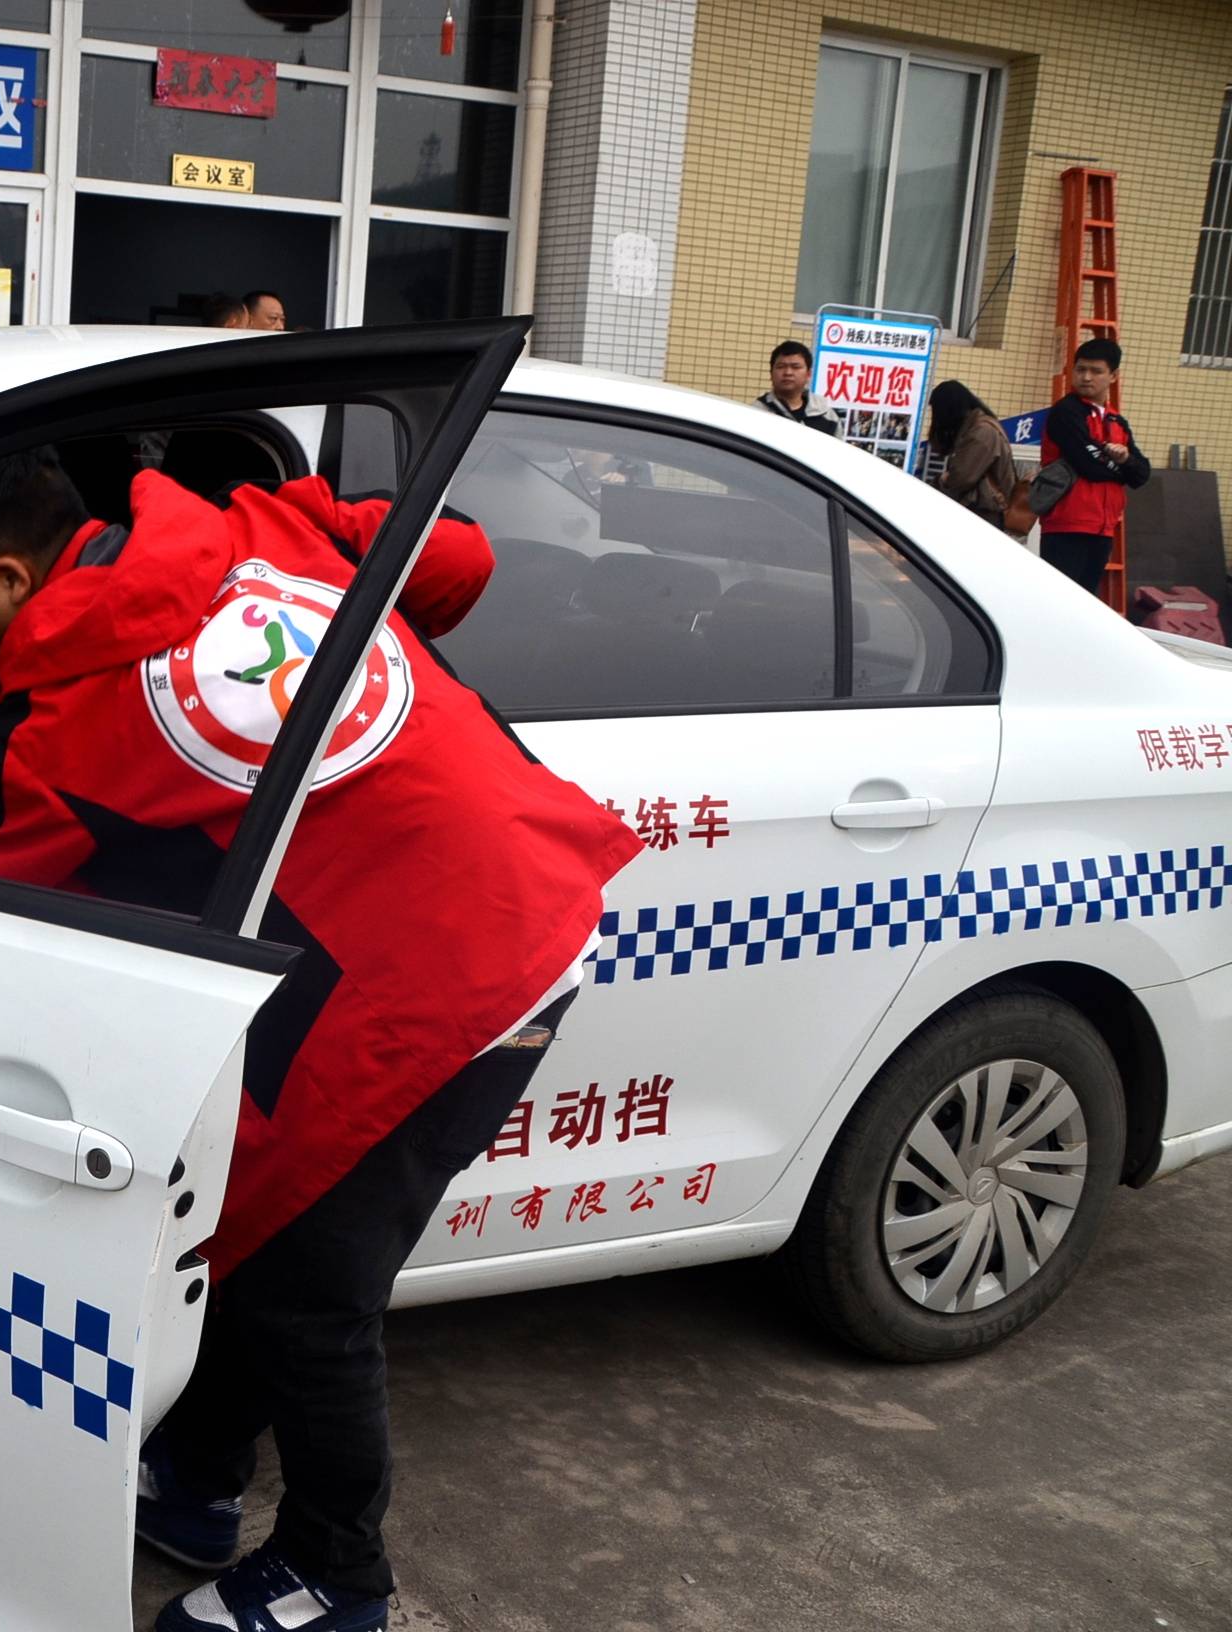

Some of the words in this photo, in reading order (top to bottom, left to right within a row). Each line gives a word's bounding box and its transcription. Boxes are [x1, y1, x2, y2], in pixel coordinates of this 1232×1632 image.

[181, 162, 246, 188] 会议室
[845, 328, 927, 350] 残疾人驾车培训基地
[824, 360, 915, 407] 欢迎您
[1014, 416, 1034, 443] 校
[1136, 724, 1232, 772] 限载学
[485, 1073, 675, 1163] 自动挡
[445, 1161, 717, 1237] 训有限公司
